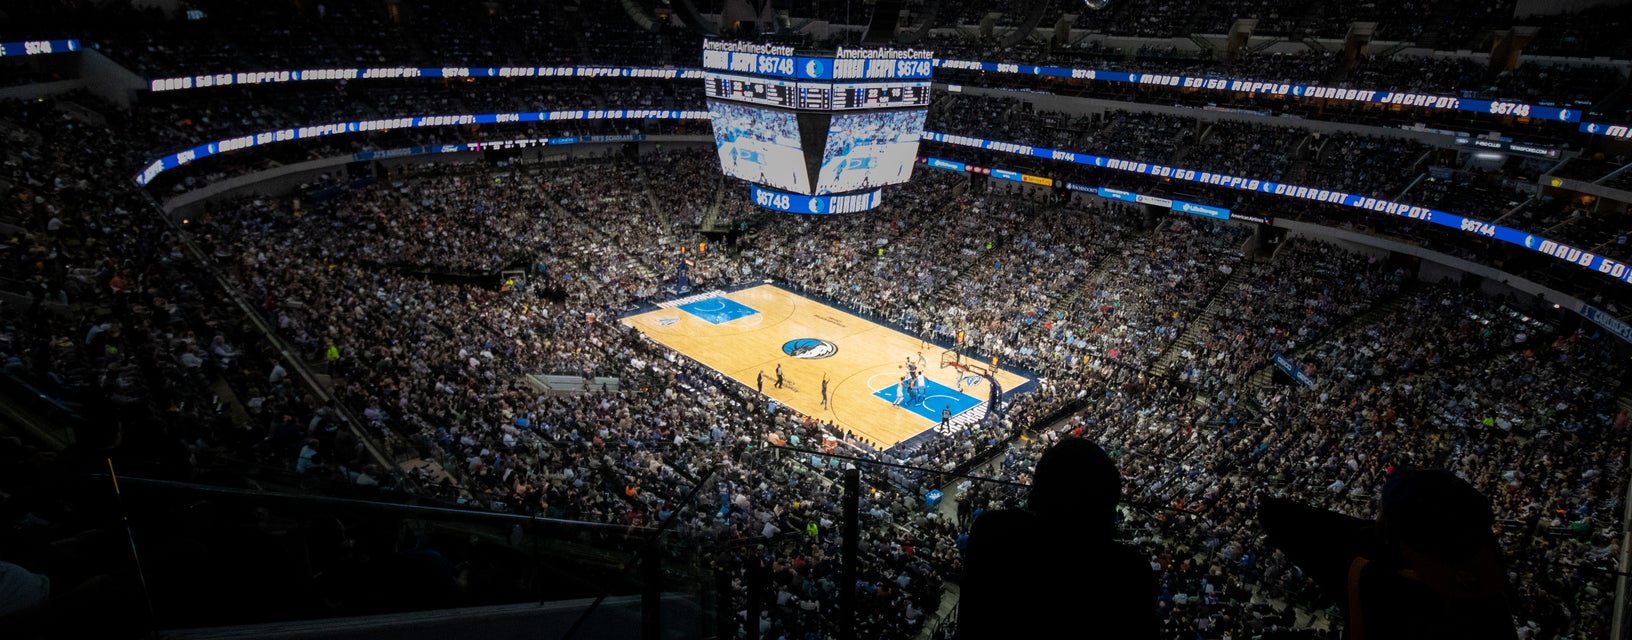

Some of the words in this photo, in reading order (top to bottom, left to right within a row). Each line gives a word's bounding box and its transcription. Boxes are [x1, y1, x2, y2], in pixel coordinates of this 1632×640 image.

[758, 55, 794, 75] $6748
[897, 60, 931, 78] $6748
[1183, 77, 1227, 90] 50/50
[1231, 81, 1290, 94] RAFFLE
[1304, 86, 1376, 102] CURRENT
[1381, 92, 1459, 109] JACKPOT:
[1490, 101, 1530, 117] $6748
[1107, 159, 1147, 174] MAVS
[1151, 165, 1195, 180] 50/50
[1200, 171, 1260, 190] RAFFLE
[756, 189, 790, 210] $6748
[1275, 183, 1349, 206] CURRENT
[1353, 196, 1432, 221] JACKPOT:
[1461, 218, 1496, 237] $6744
[1538, 240, 1595, 267] MAVS
